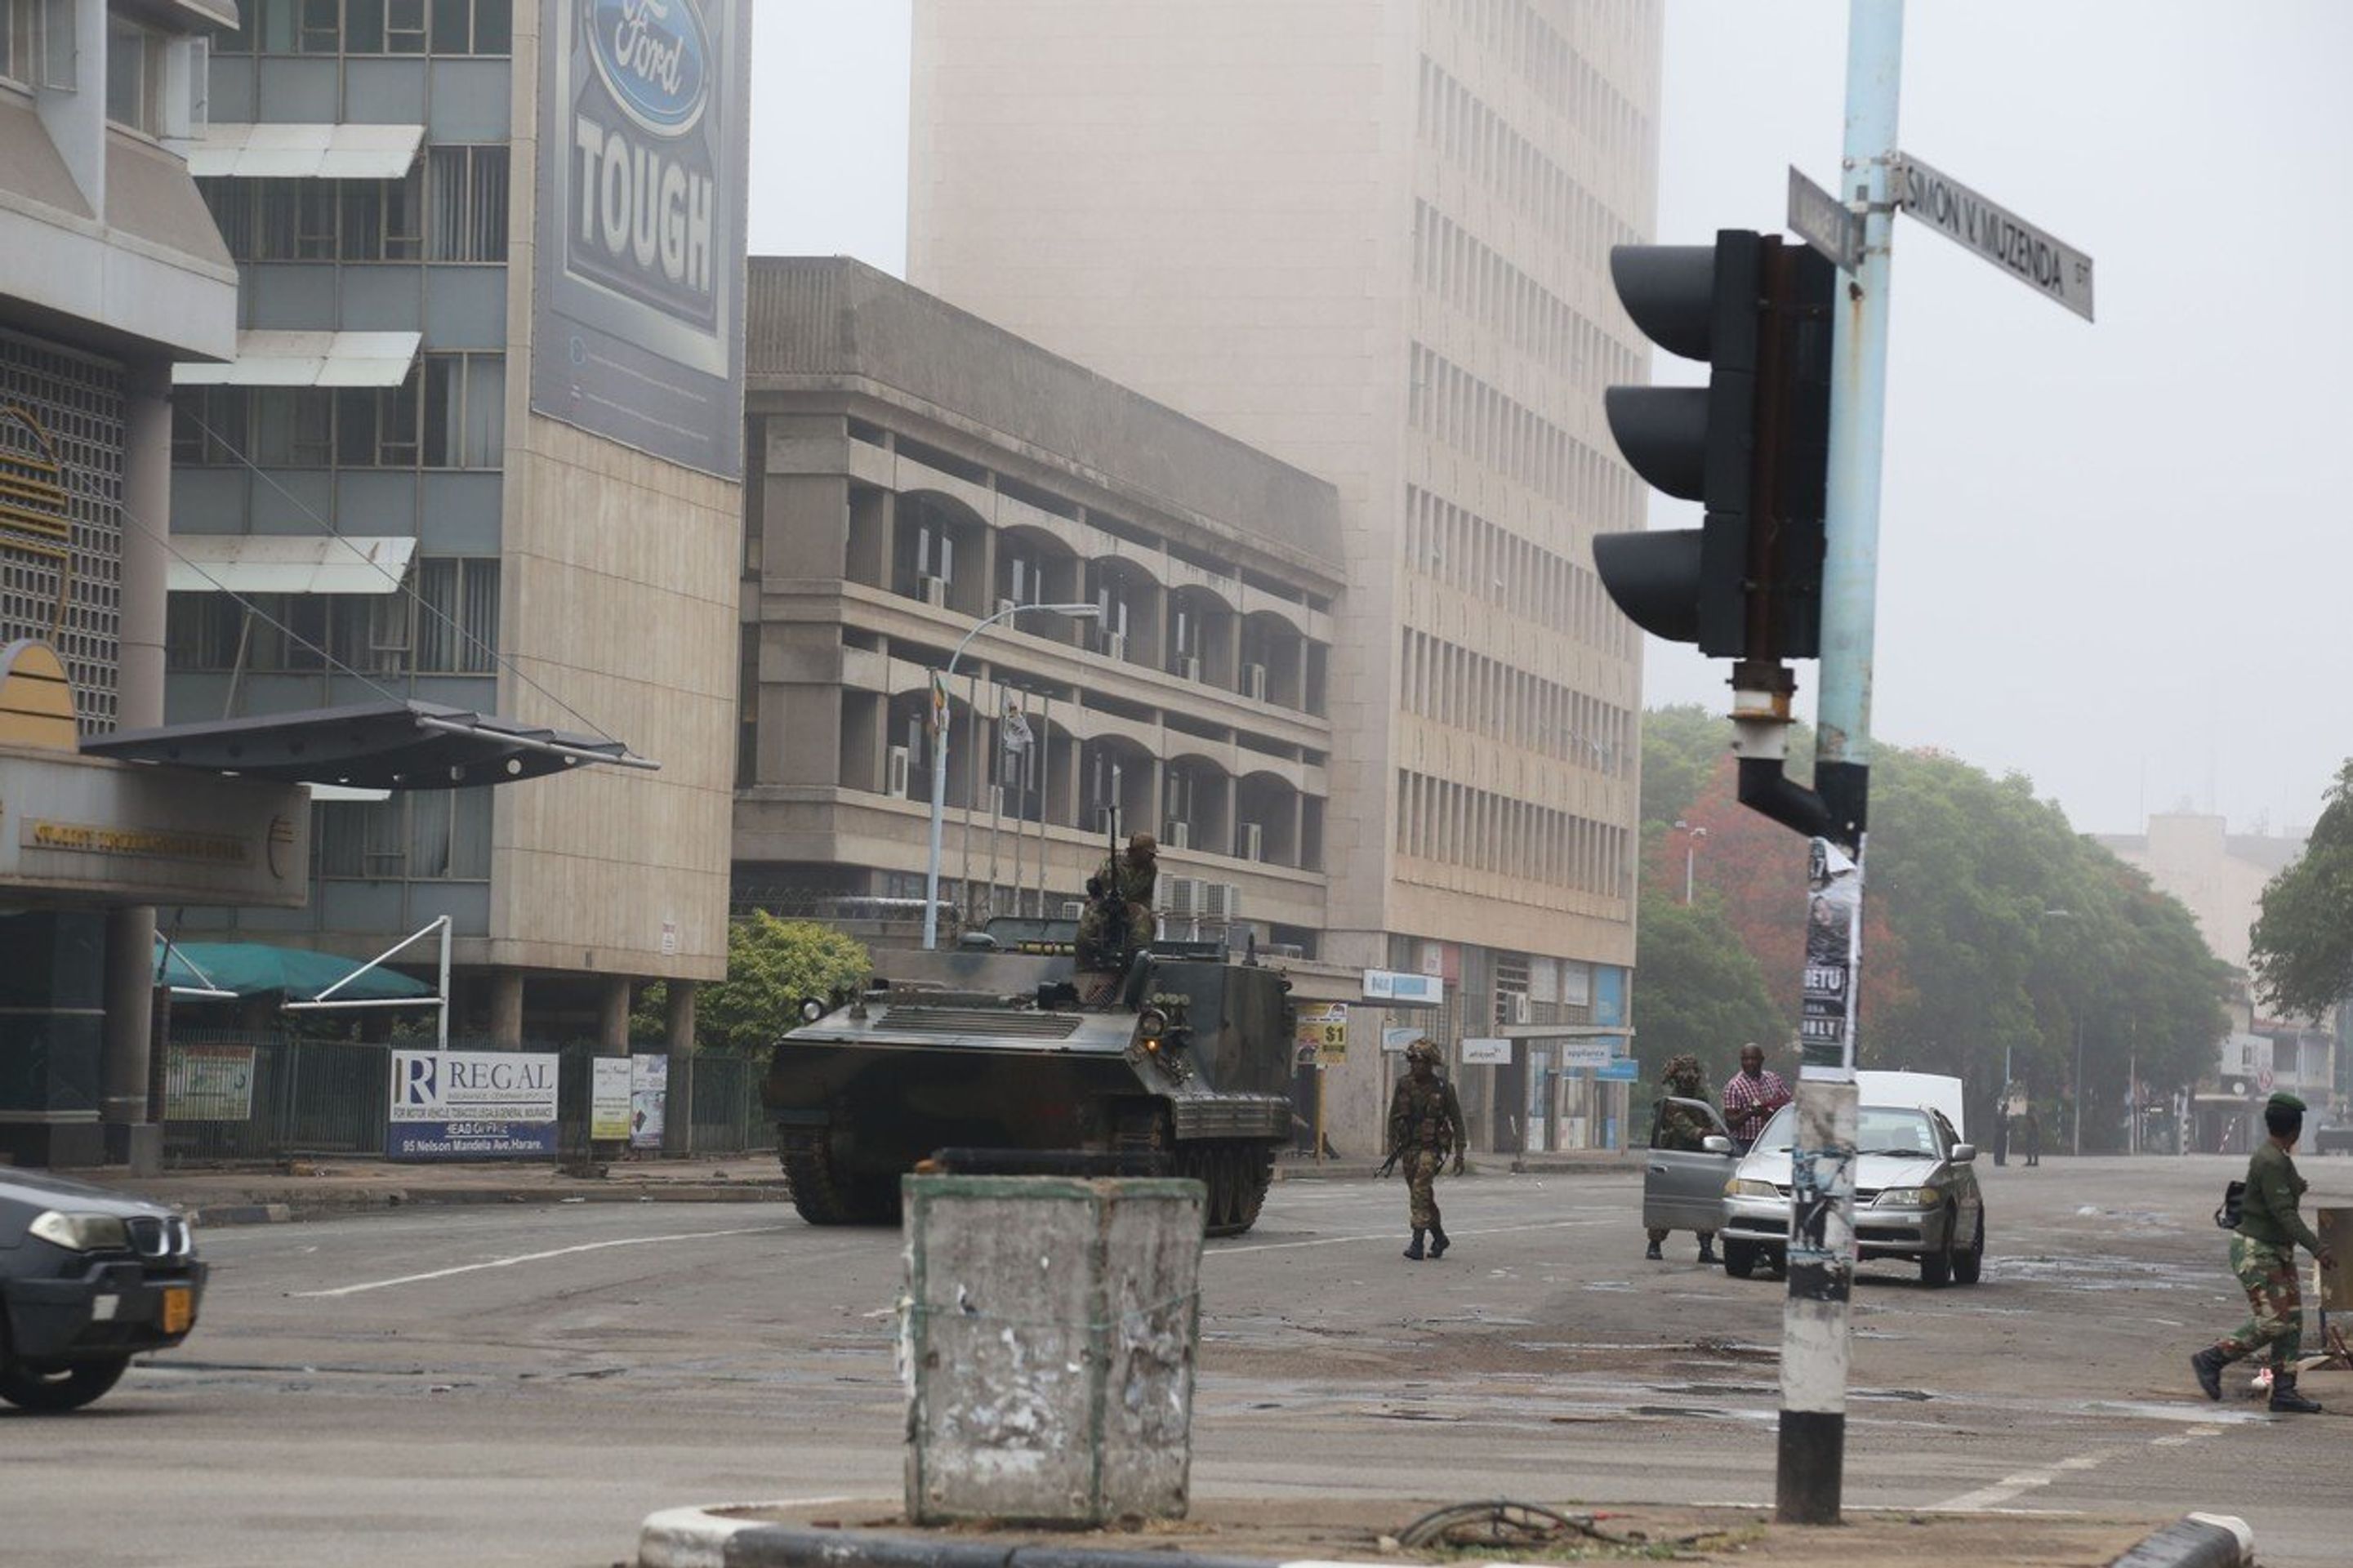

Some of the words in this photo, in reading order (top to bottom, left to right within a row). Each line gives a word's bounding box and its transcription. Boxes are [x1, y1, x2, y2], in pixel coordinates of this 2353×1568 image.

[615, 0, 683, 96] Ford
[576, 114, 713, 292] TOUGH
[1907, 166, 1959, 234] SIMON
[1981, 207, 2064, 296] MUZENDA
[1325, 1025, 1344, 1043] $1
[449, 1062, 553, 1089] REGAL
[417, 1140, 451, 1152] Nelson
[452, 1139, 491, 1152] Mandela
